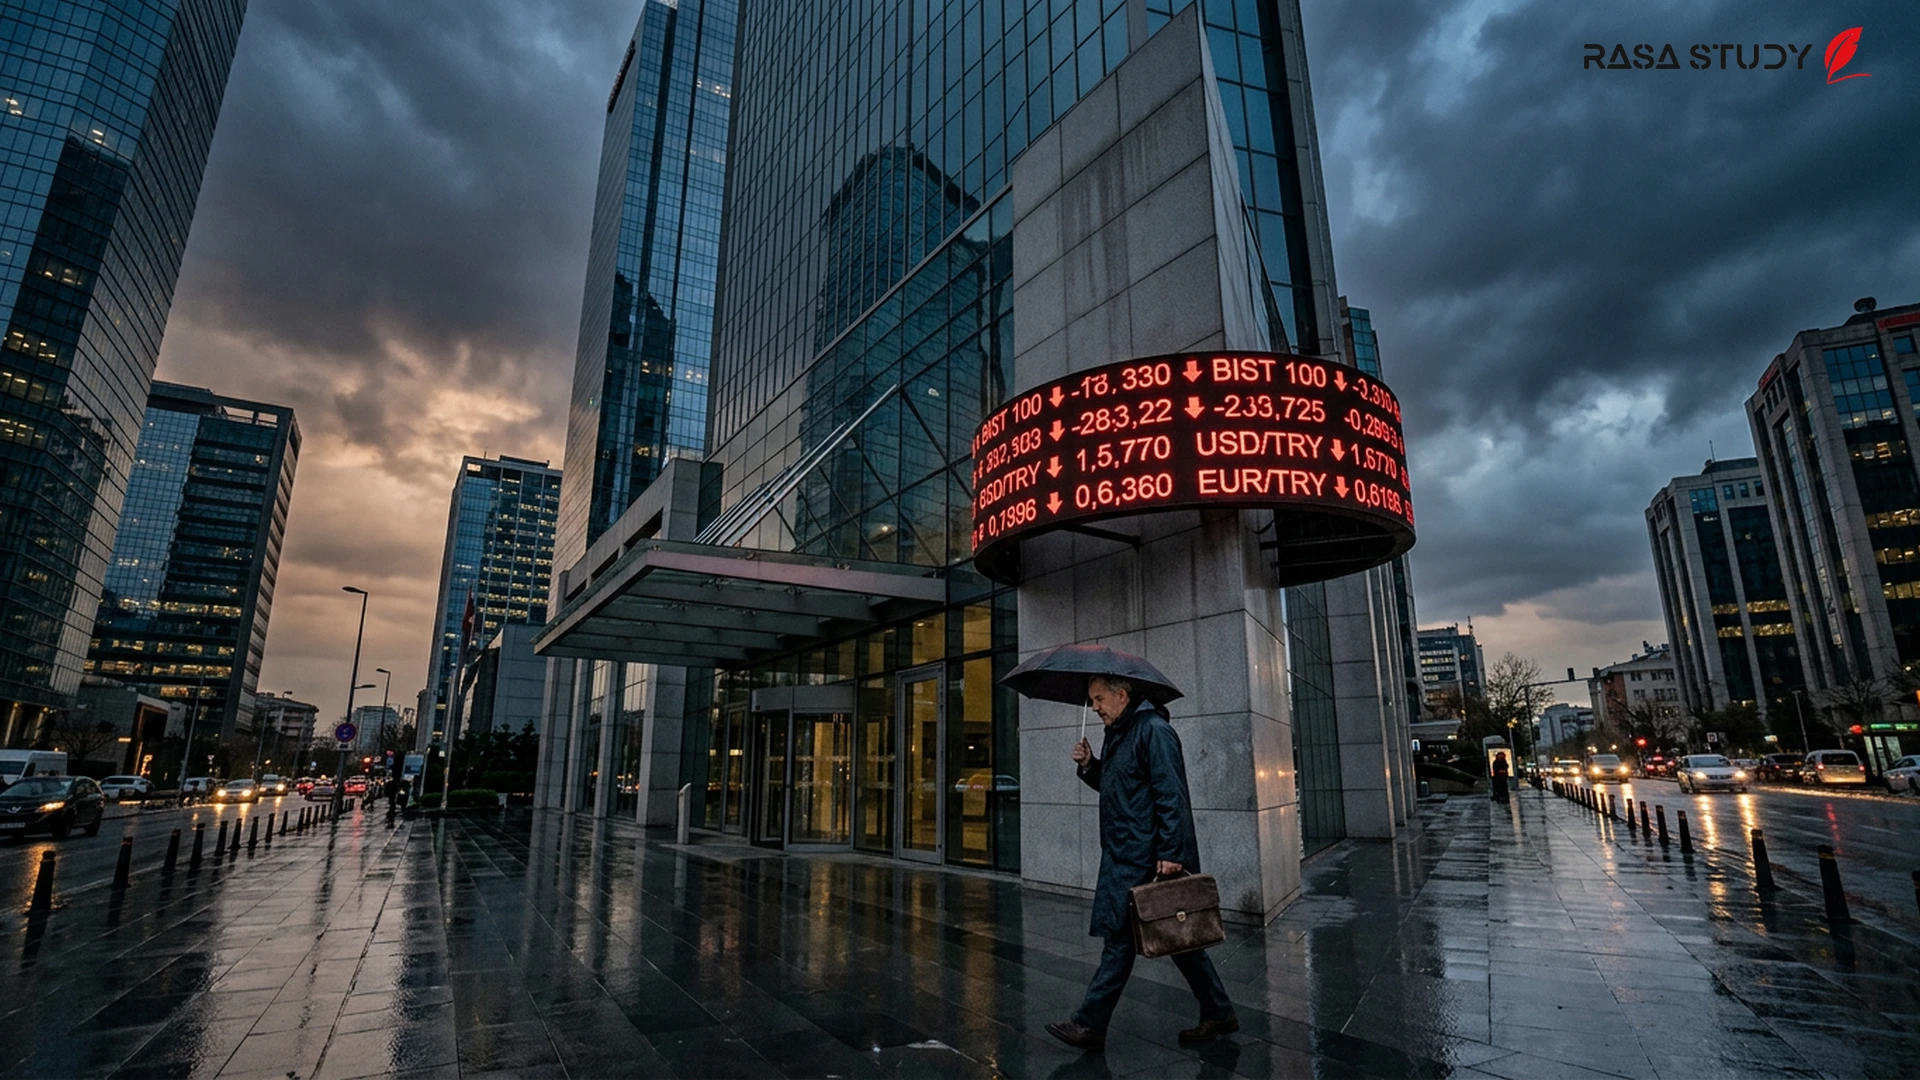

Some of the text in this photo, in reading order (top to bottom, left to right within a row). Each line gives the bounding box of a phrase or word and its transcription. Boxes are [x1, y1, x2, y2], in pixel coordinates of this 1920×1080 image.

[1012, 393, 1042, 424] 100
[1212, 358, 1276, 382] BIST
[1285, 361, 1327, 388] 100
[1076, 435, 1171, 473] 1,5,770
[1196, 431, 1324, 459] USD/TRY
[1075, 473, 1173, 510] 0,6,360
[1198, 469, 1327, 497] EUR/TRY
